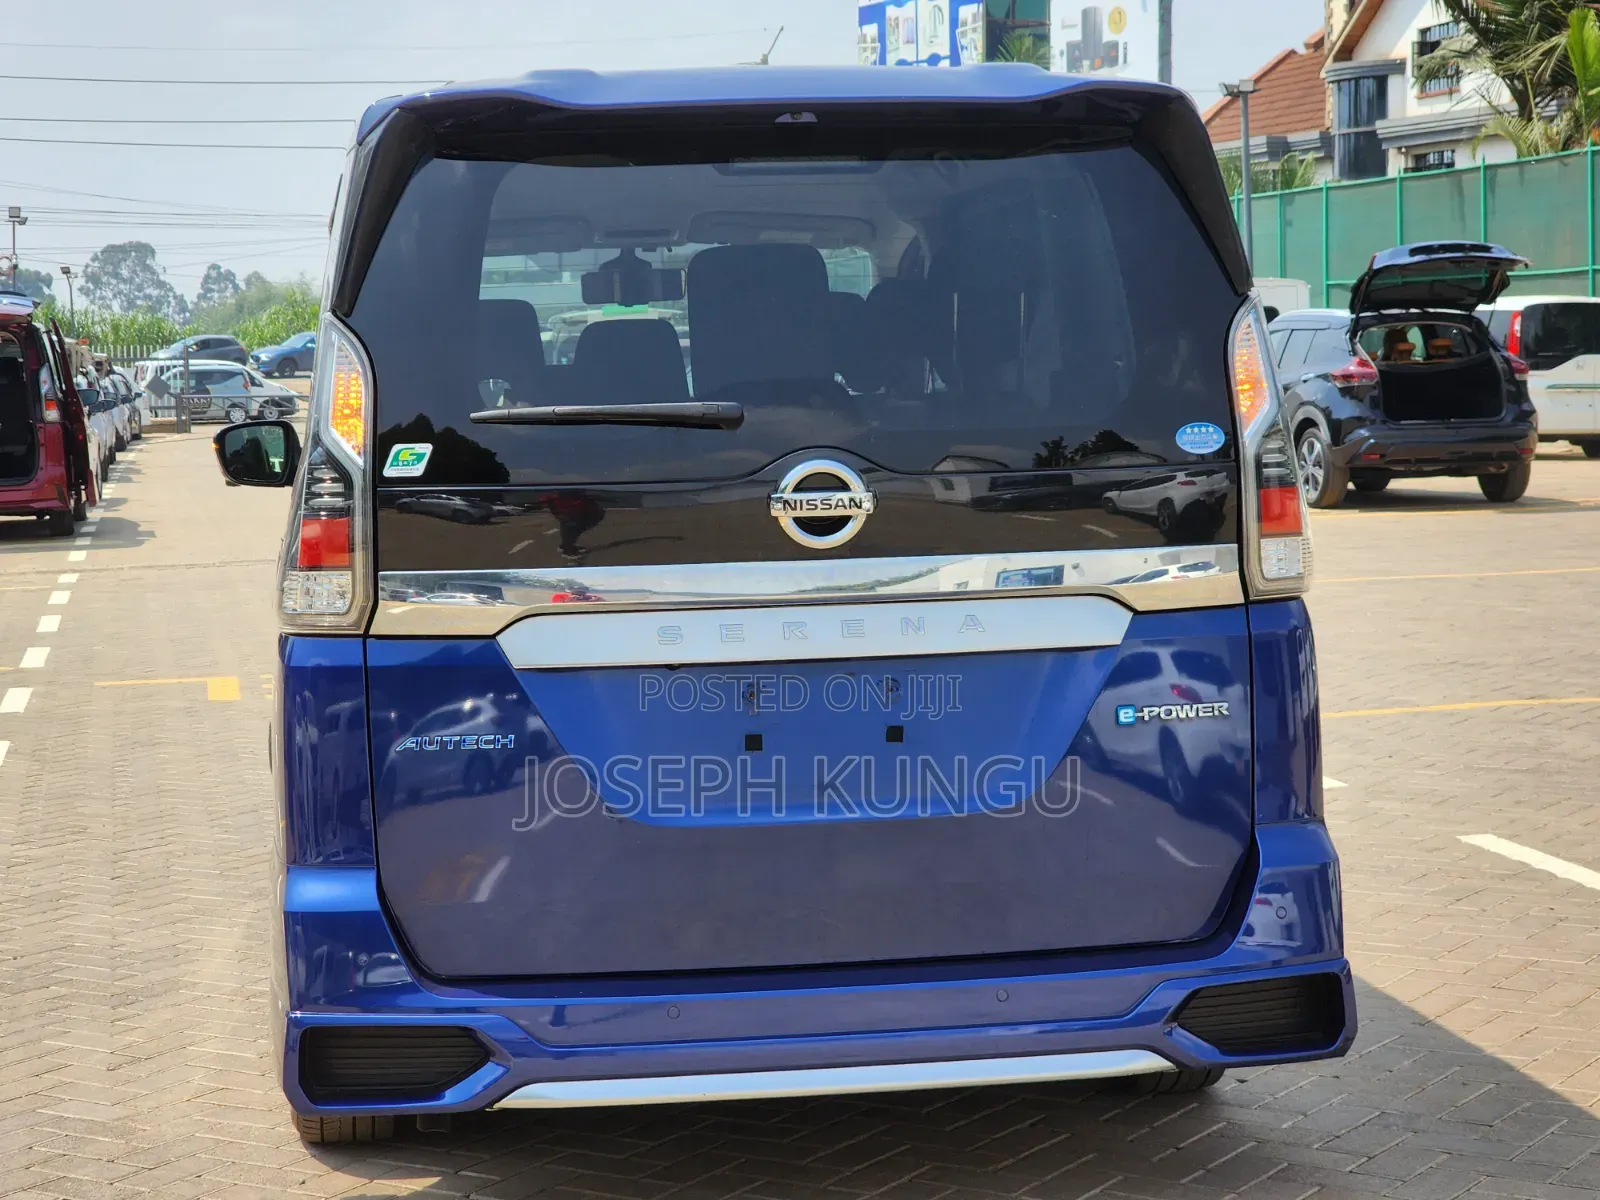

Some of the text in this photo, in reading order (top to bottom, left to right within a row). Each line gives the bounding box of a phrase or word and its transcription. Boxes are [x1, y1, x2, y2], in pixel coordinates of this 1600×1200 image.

[782, 497, 862, 511] NISSAN
[656, 614, 986, 646] SERENA
[1118, 702, 1230, 724] e-POWER
[395, 734, 515, 751] AUTECH
